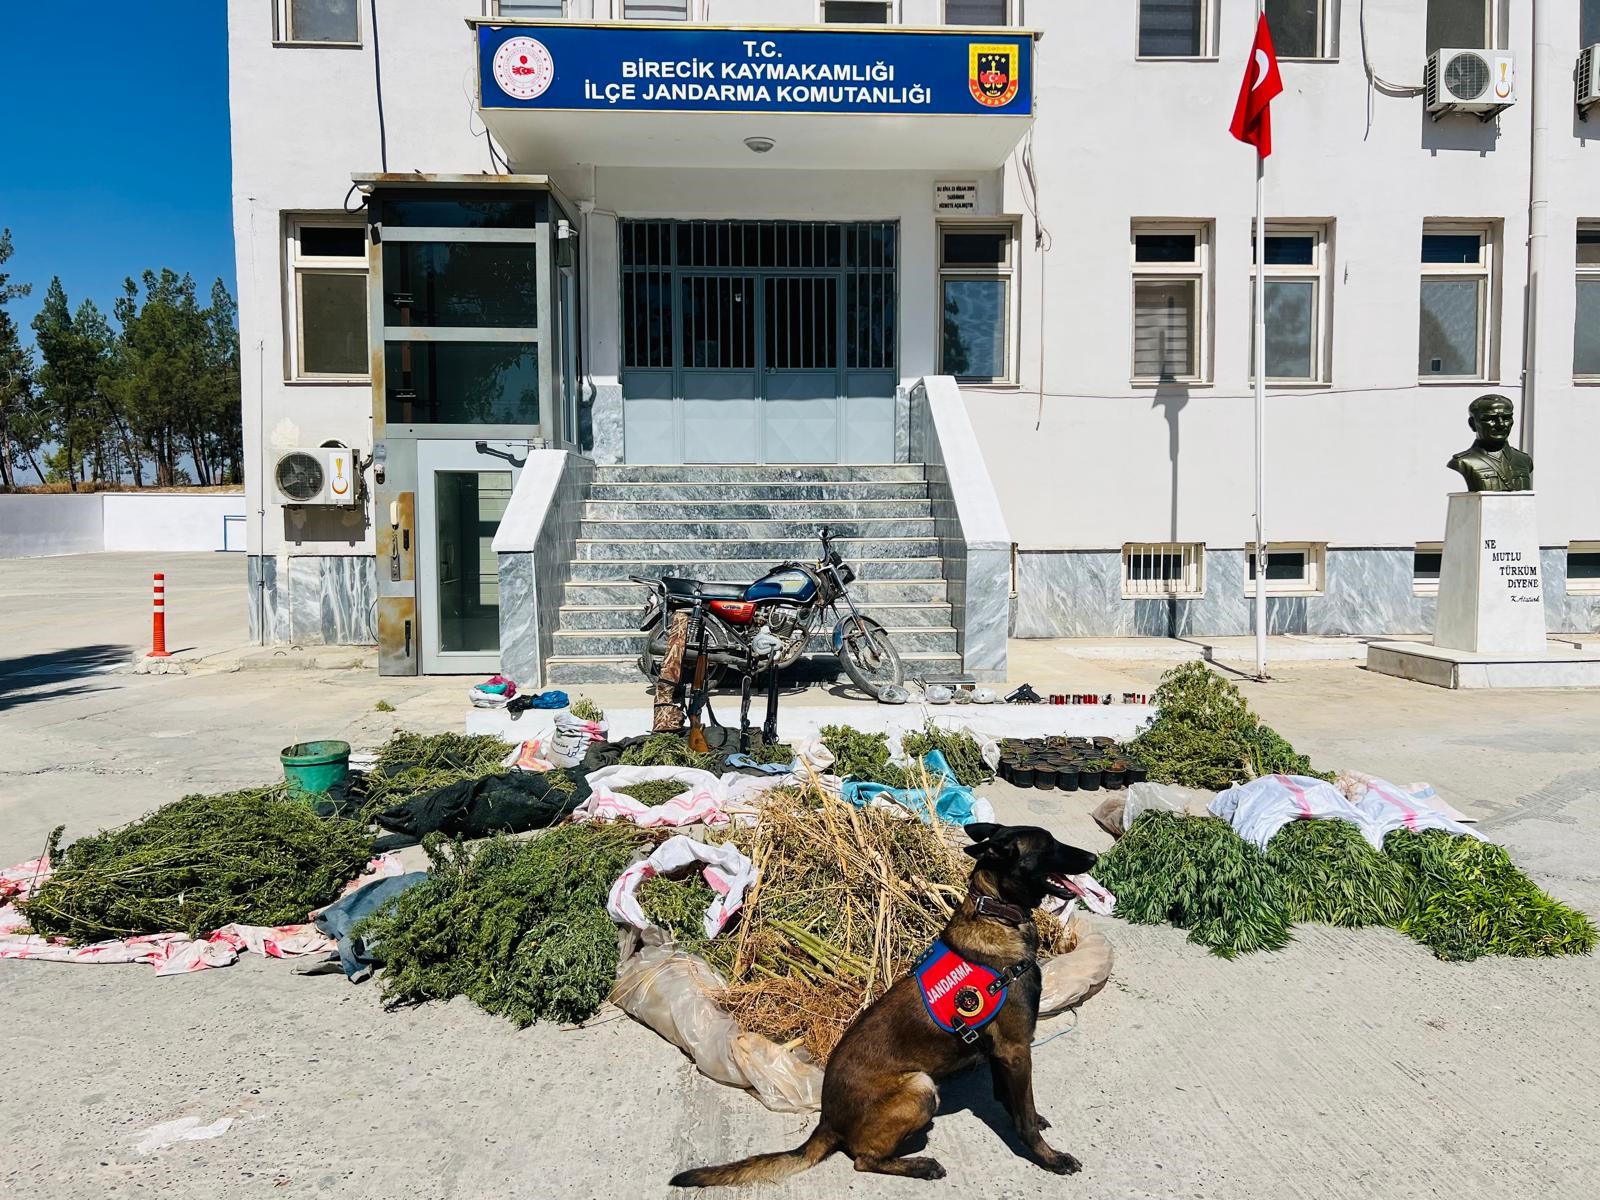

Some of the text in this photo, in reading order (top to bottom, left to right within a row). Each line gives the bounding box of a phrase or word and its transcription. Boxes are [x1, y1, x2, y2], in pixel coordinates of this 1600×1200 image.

[742, 40, 783, 58] T.C.
[622, 57, 895, 81] BİRECİK KAYMAKAMLIĞI
[584, 79, 932, 104] İLÇE JANDARMA KOMUTANLIĞI
[1484, 539, 1497, 549] NE
[1492, 552, 1522, 561] MUTLU
[1499, 565, 1537, 576] TÜRKÜM
[926, 961, 973, 1004] JANDARMA
